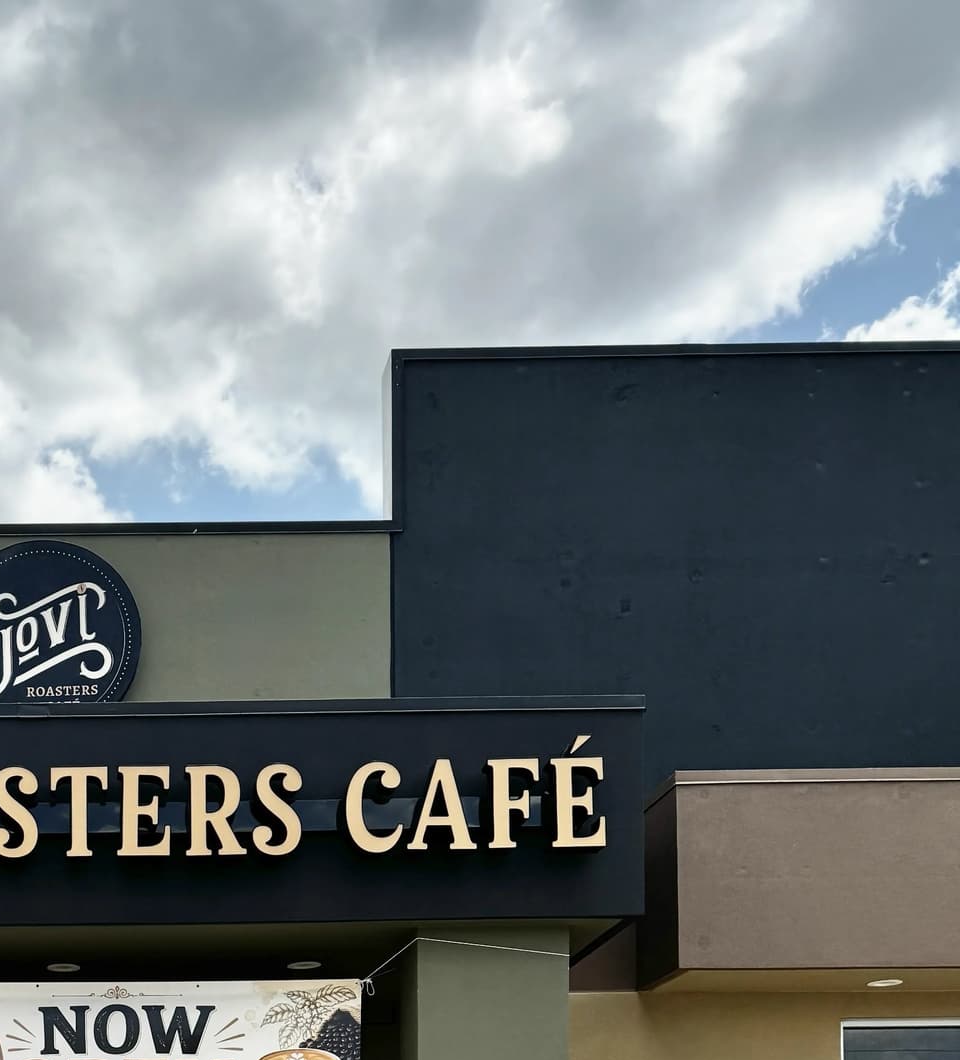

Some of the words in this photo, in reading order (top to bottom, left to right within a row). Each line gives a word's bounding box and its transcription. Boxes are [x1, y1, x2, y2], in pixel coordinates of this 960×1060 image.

[26, 684, 98, 698] ROASTERS
[345, 735, 607, 854] CAFÉ
[38, 1004, 216, 1055] NOW
